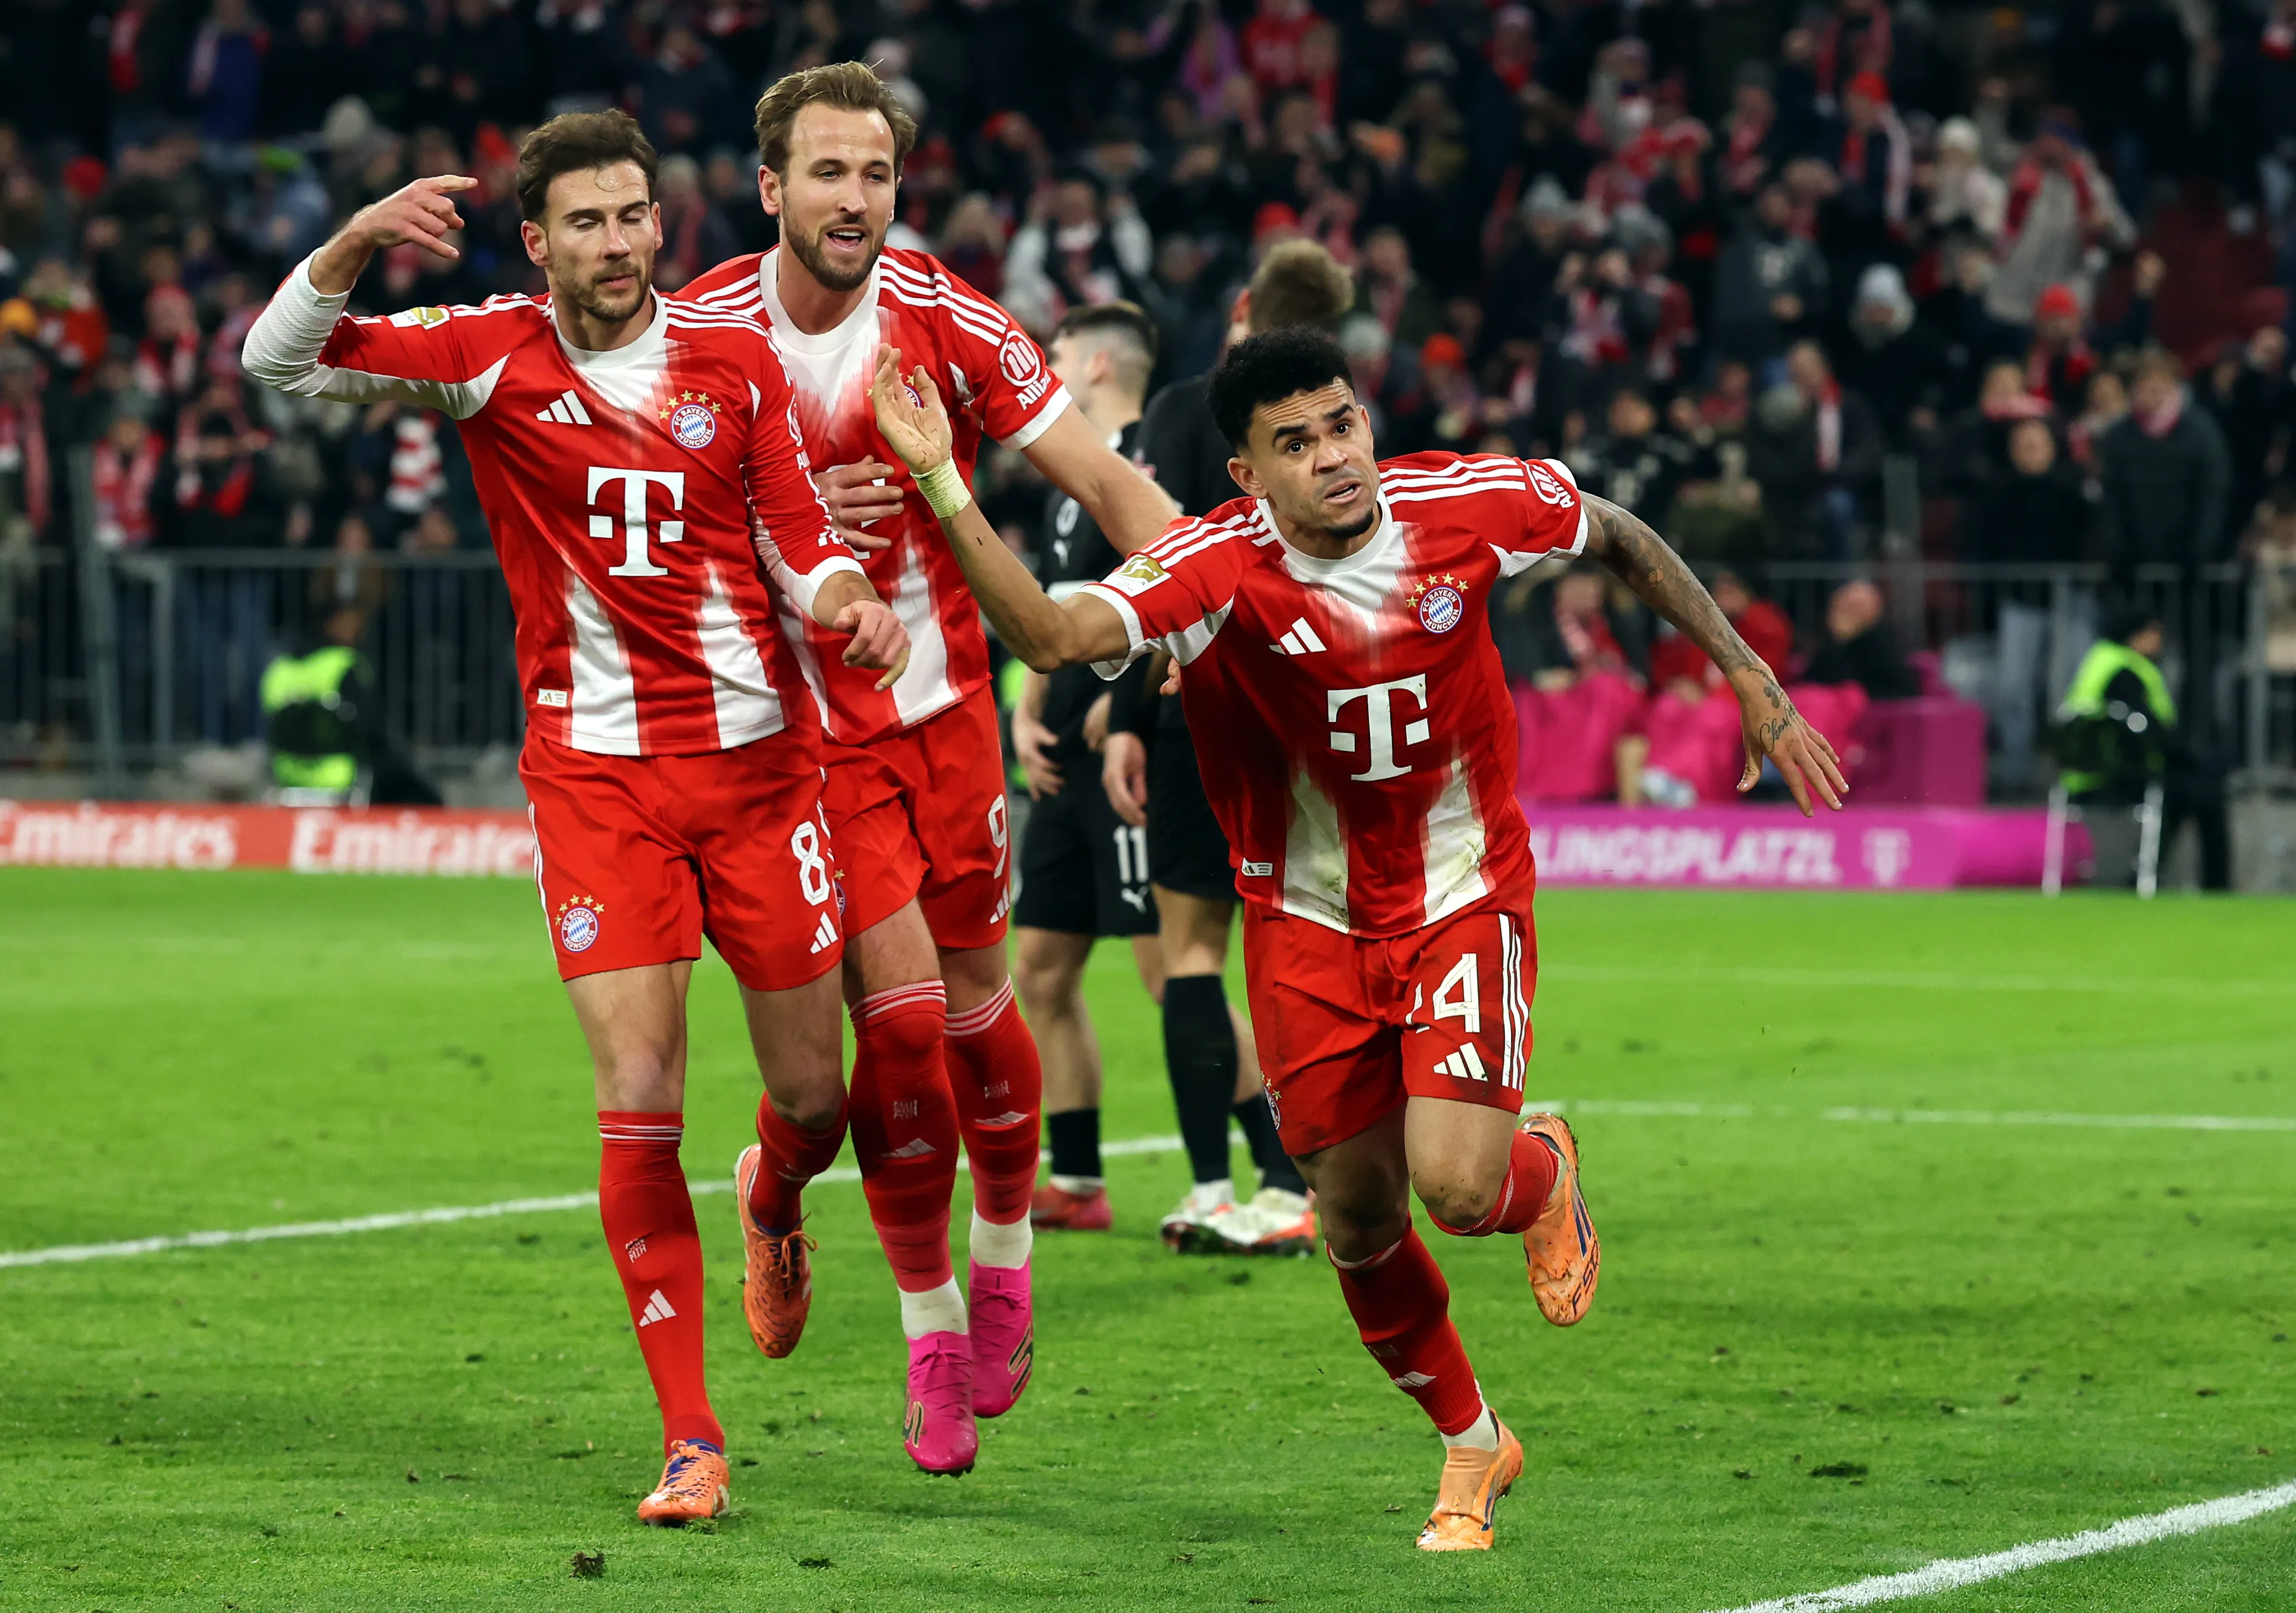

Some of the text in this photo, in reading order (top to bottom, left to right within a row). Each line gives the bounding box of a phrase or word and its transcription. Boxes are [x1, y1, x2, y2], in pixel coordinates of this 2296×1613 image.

[674, 408, 710, 425] FC BAYERN
[587, 466, 685, 576] T
[1423, 590, 1458, 612] FC BAYERN
[1327, 674, 1430, 781] T
[289, 809, 537, 878] Emirate
[791, 821, 830, 906] 8
[988, 793, 1007, 879] 9
[1114, 825, 1149, 884] 11
[563, 910, 594, 931] FC BAYERN
